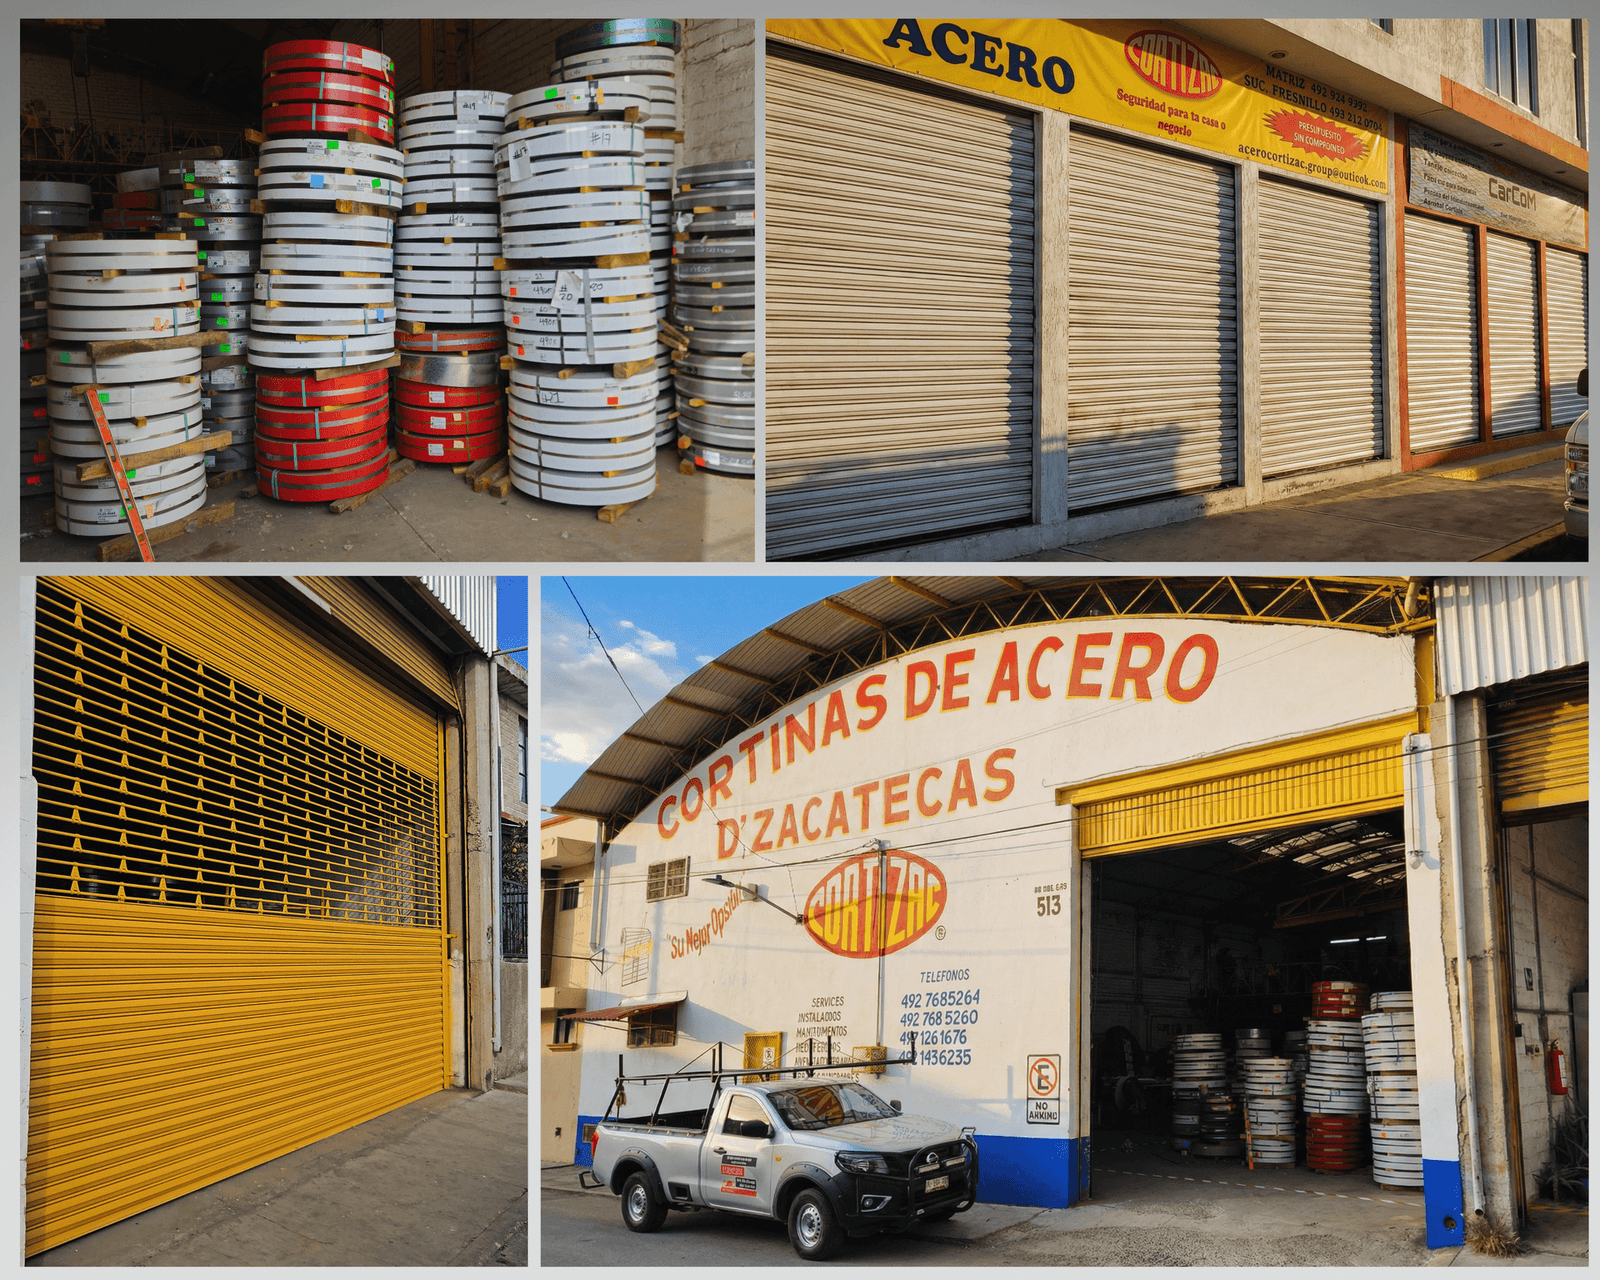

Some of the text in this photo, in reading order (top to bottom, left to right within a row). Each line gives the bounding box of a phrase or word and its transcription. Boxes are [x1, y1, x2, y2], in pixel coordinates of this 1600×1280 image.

[882, 18, 1075, 95] ACERO
[1266, 65, 1306, 90] MATRIZ
[1244, 74, 1269, 93] SUC.
[1272, 84, 1327, 113] FRESNILLO
[1117, 88, 1166, 113] Seguridad
[1168, 106, 1188, 118] para
[1201, 116, 1219, 129] casa
[1220, 121, 1226, 130] o
[656, 631, 1220, 841] CORTINAS DE ACERO
[1036, 894, 1061, 917] 513
[920, 968, 970, 983] TELEFONOS
[811, 995, 845, 1008] SERVICES
[901, 988, 981, 1009] 492 7685264
[899, 1011, 919, 1027] 492
[1035, 1101, 1048, 1111] NO
